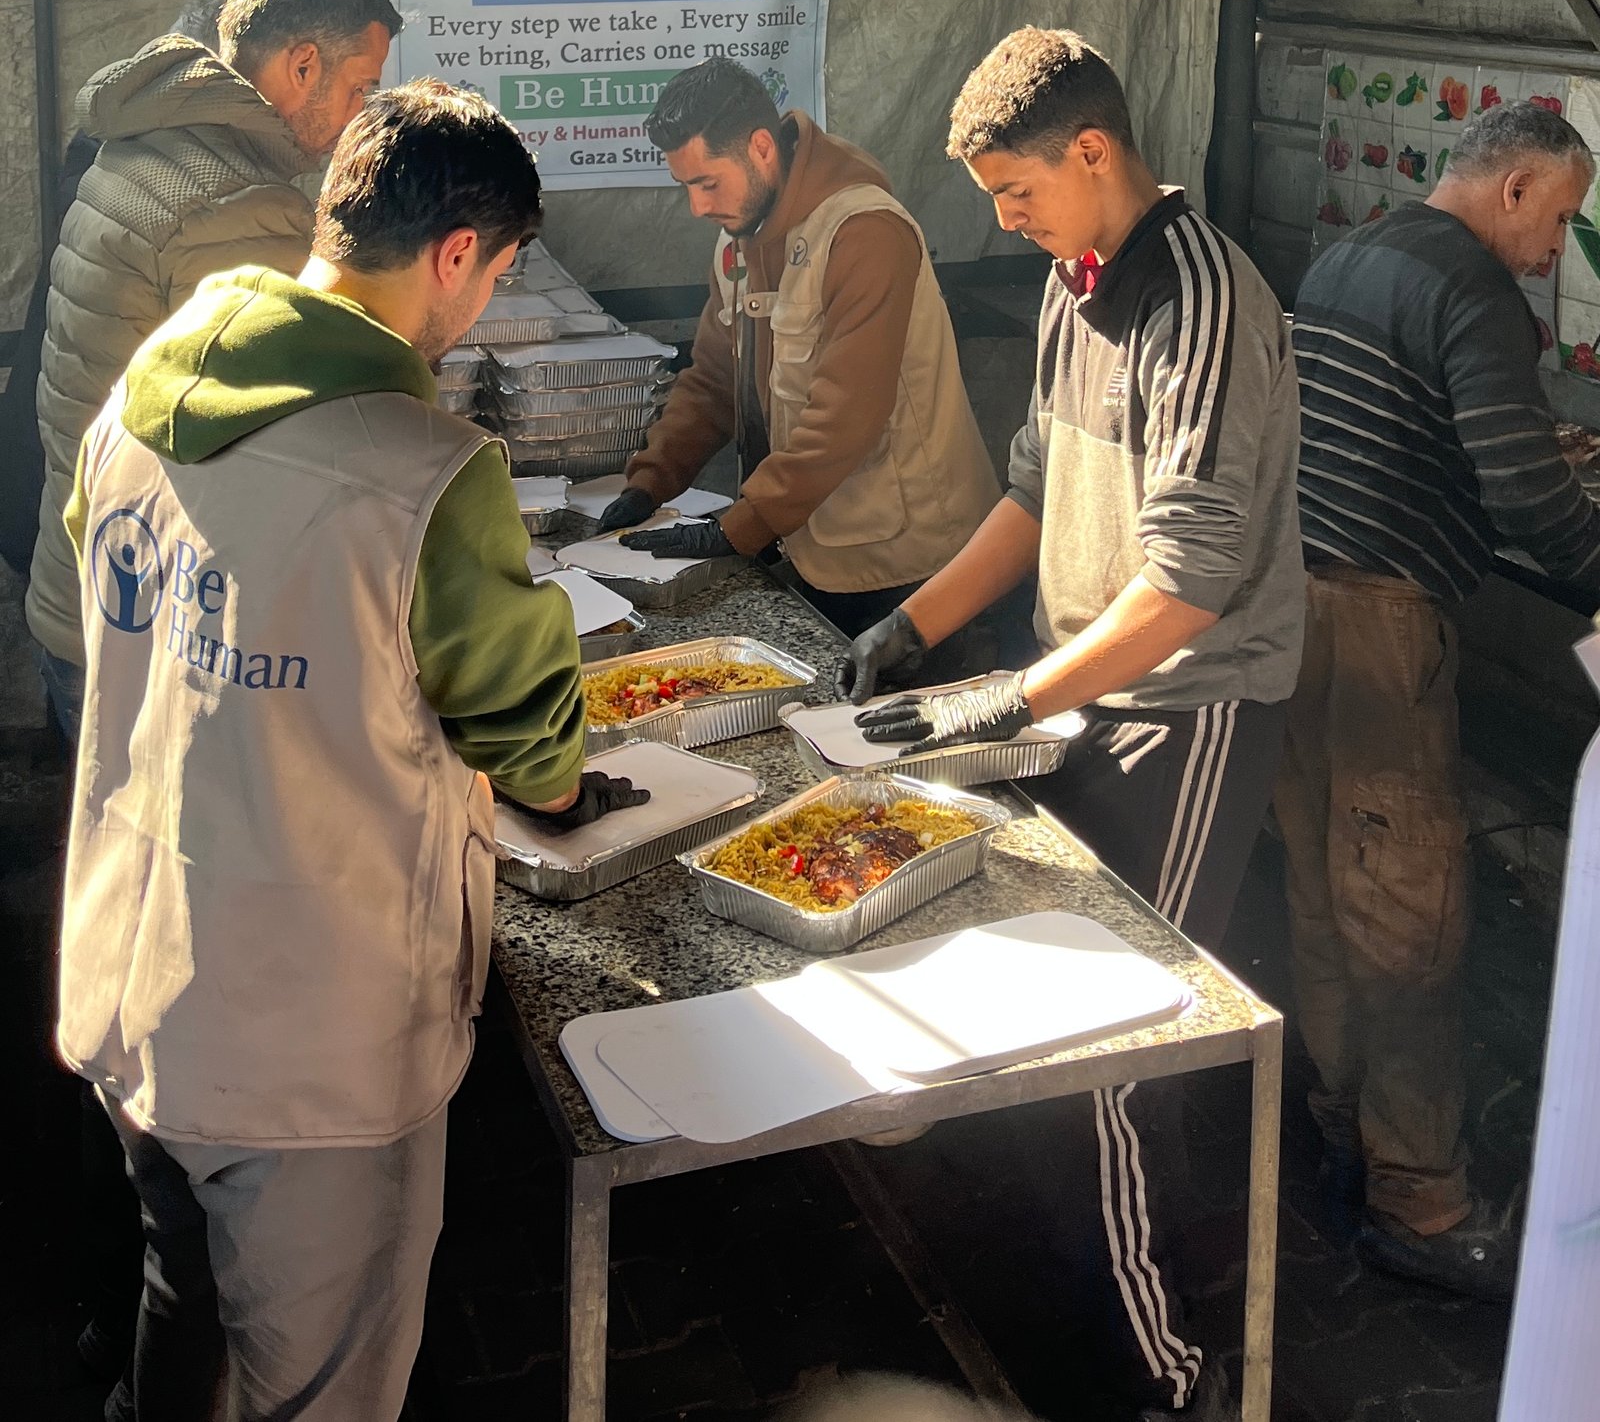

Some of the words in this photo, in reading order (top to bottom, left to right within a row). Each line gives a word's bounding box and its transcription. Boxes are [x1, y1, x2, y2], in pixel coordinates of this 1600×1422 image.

[427, 15, 502, 41] Every
[511, 15, 560, 39] step
[568, 16, 601, 33] we
[608, 10, 657, 32] take
[680, 8, 749, 33] Every
[757, 4, 807, 27] smile
[435, 51, 471, 68] we
[478, 43, 551, 70] bring,
[560, 40, 646, 64] Carries
[654, 43, 696, 60] one
[703, 39, 790, 60] message
[514, 80, 565, 110] Be
[580, 77, 667, 108] Hum
[518, 129, 549, 146] ncy
[553, 125, 567, 141] &
[570, 150, 617, 165] Gaza
[622, 146, 666, 166] Strip
[172, 539, 224, 614] Be
[167, 603, 309, 690] Human
